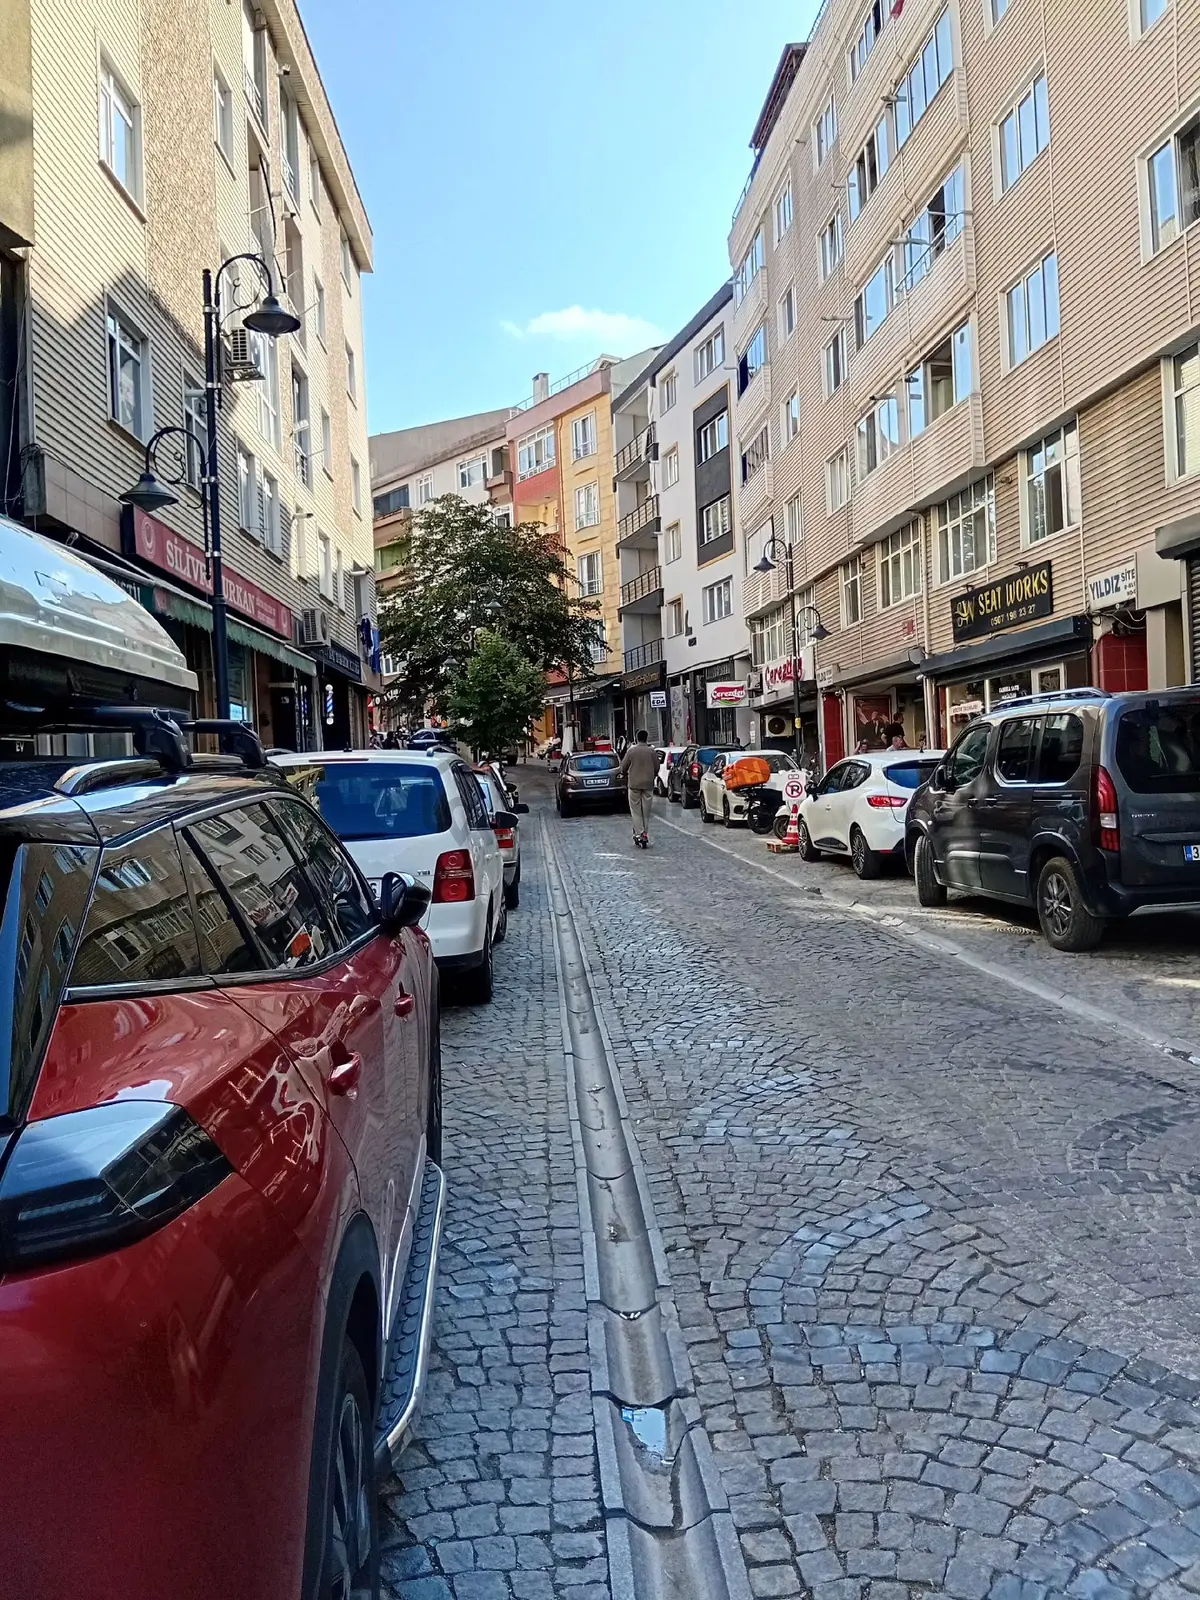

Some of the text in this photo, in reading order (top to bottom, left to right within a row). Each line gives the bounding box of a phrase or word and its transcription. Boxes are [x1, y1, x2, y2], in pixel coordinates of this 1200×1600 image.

[221, 575, 255, 615] URKAN
[978, 586, 1002, 616] SEAT
[1005, 569, 1048, 607] WORKS
[1089, 574, 1121, 600] YILDIZ
